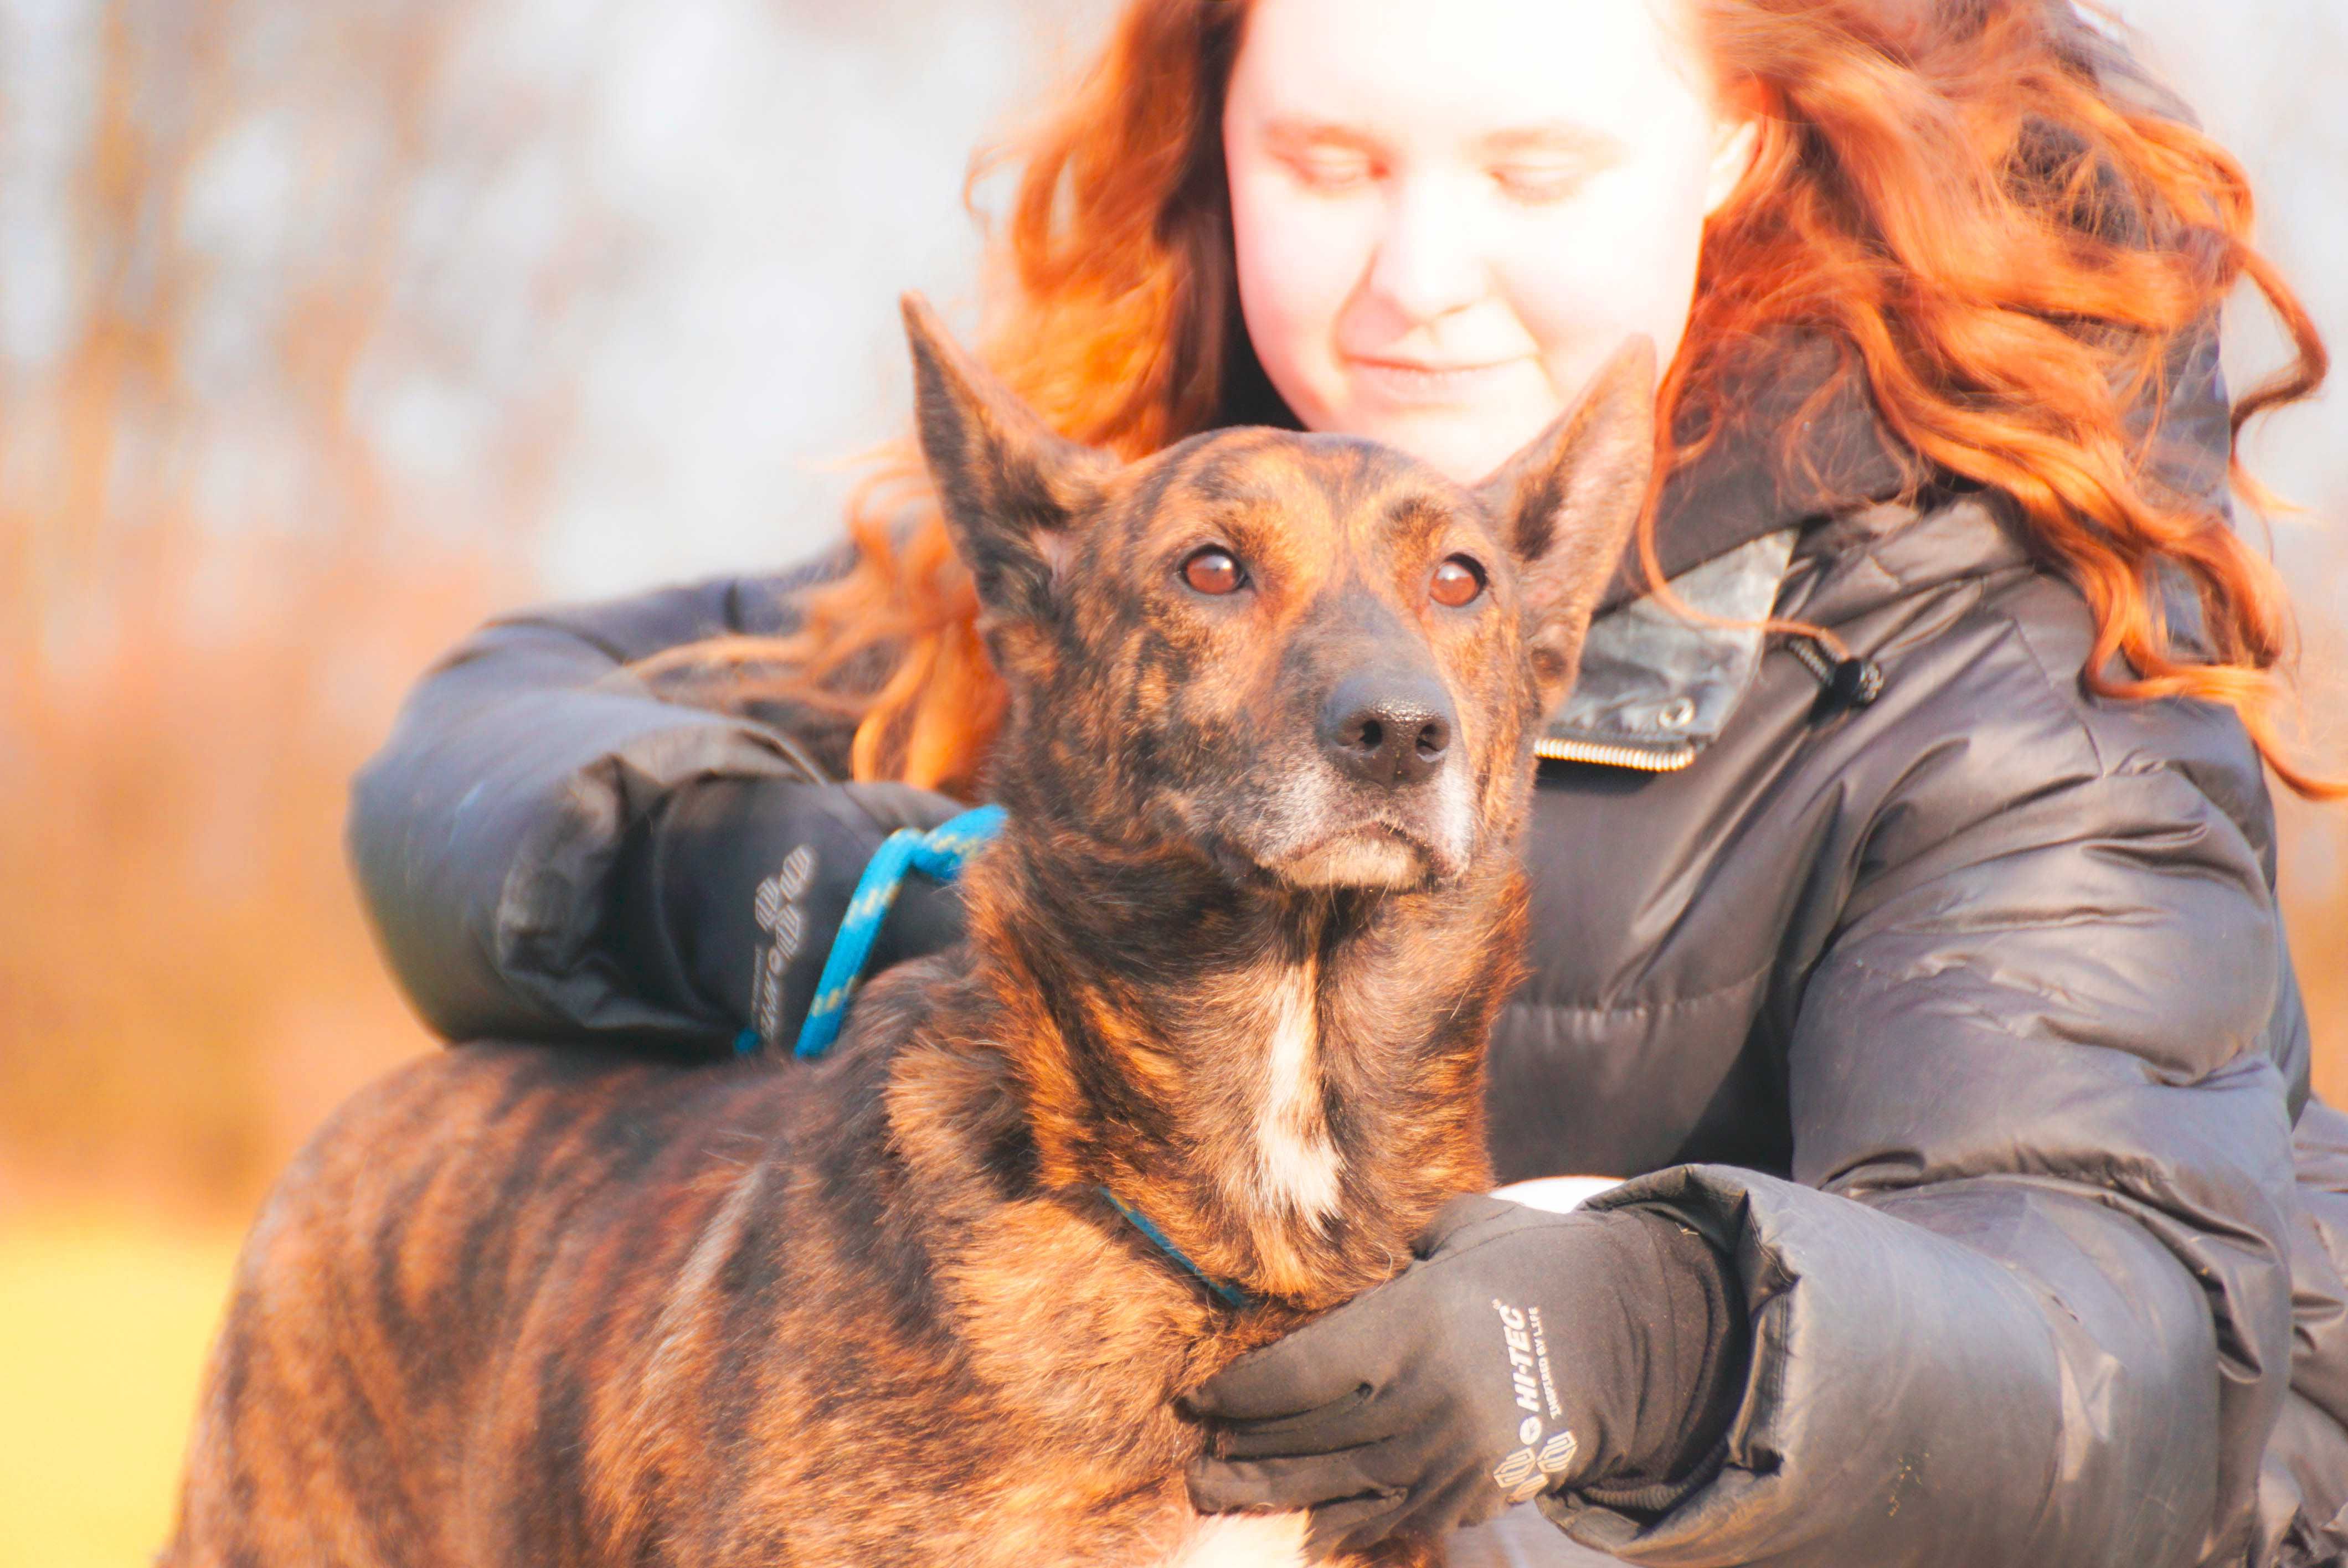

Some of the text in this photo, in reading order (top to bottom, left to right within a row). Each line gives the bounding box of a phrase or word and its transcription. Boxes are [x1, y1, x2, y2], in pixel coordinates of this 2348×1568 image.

[1528, 1307, 1543, 1337] LIFE
[1499, 1305, 1541, 1412] HI-TEC
[1534, 1338, 1548, 1356] BY
